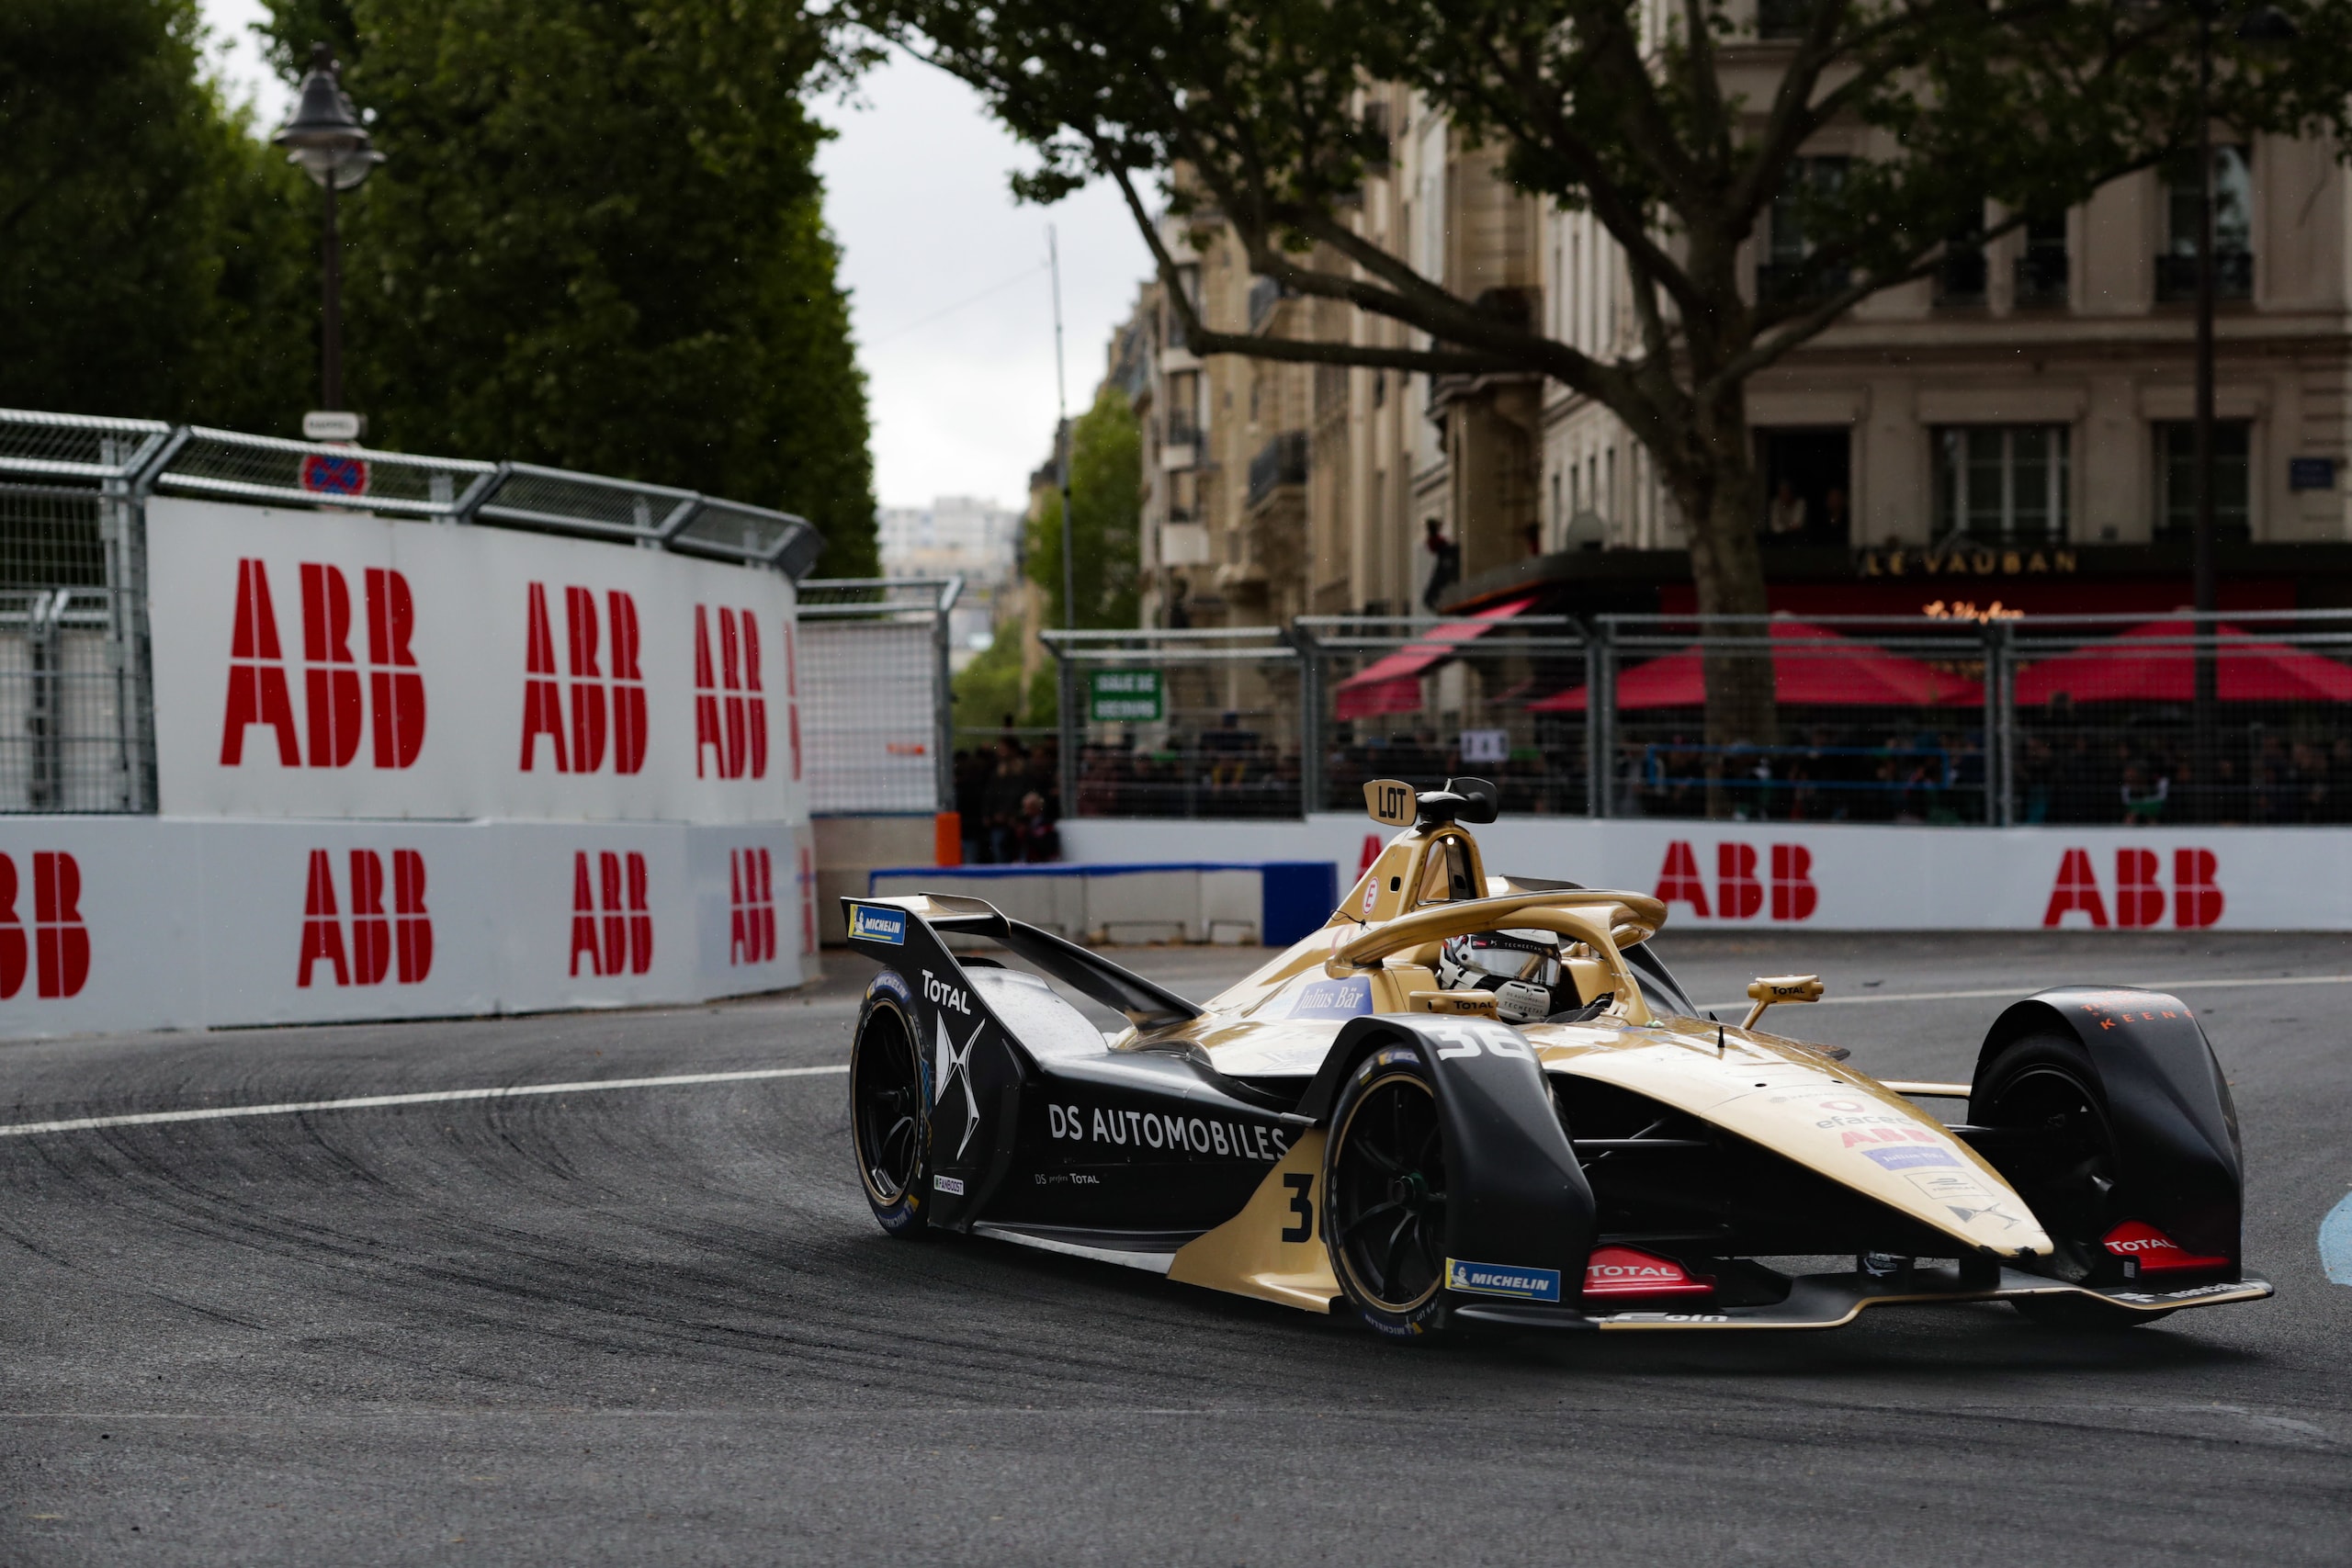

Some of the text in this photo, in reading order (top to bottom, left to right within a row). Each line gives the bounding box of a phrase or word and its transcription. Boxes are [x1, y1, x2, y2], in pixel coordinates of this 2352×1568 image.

[1867, 551, 2076, 575] LE VAUBAN
[220, 558, 426, 769] ABB
[520, 581, 649, 774] ABB
[695, 604, 768, 779] ABB
[1379, 785, 1406, 819] LOT
[1655, 840, 1819, 921] ABB
[2041, 847, 2225, 930] ABB
[298, 849, 433, 987] ABB
[569, 851, 653, 977] ABB
[730, 848, 775, 965] ABB
[0, 851, 91, 1000] BB
[865, 917, 901, 934] MICHELIN
[876, 975, 909, 999] MICHELIN
[922, 969, 971, 1015] TOTAL
[1300, 985, 1364, 1010] Julius Bär
[1770, 986, 1804, 995] TOTAL
[1453, 999, 1494, 1010] TOTAL
[1428, 1022, 1535, 1062] 36
[1048, 1104, 1290, 1161] DS AUTOMOBILES
[1815, 1114, 1915, 1130] efacec
[1840, 1127, 1938, 1148] ABB
[939, 1177, 964, 1194] FANBOOST
[1035, 1173, 1047, 1185] DS
[1069, 1173, 1101, 1184] TOTAL
[2105, 1239, 2177, 1253] TOTAL
[1471, 1272, 1550, 1292] MICHELIN
[1588, 1264, 1678, 1278] TOTAL
